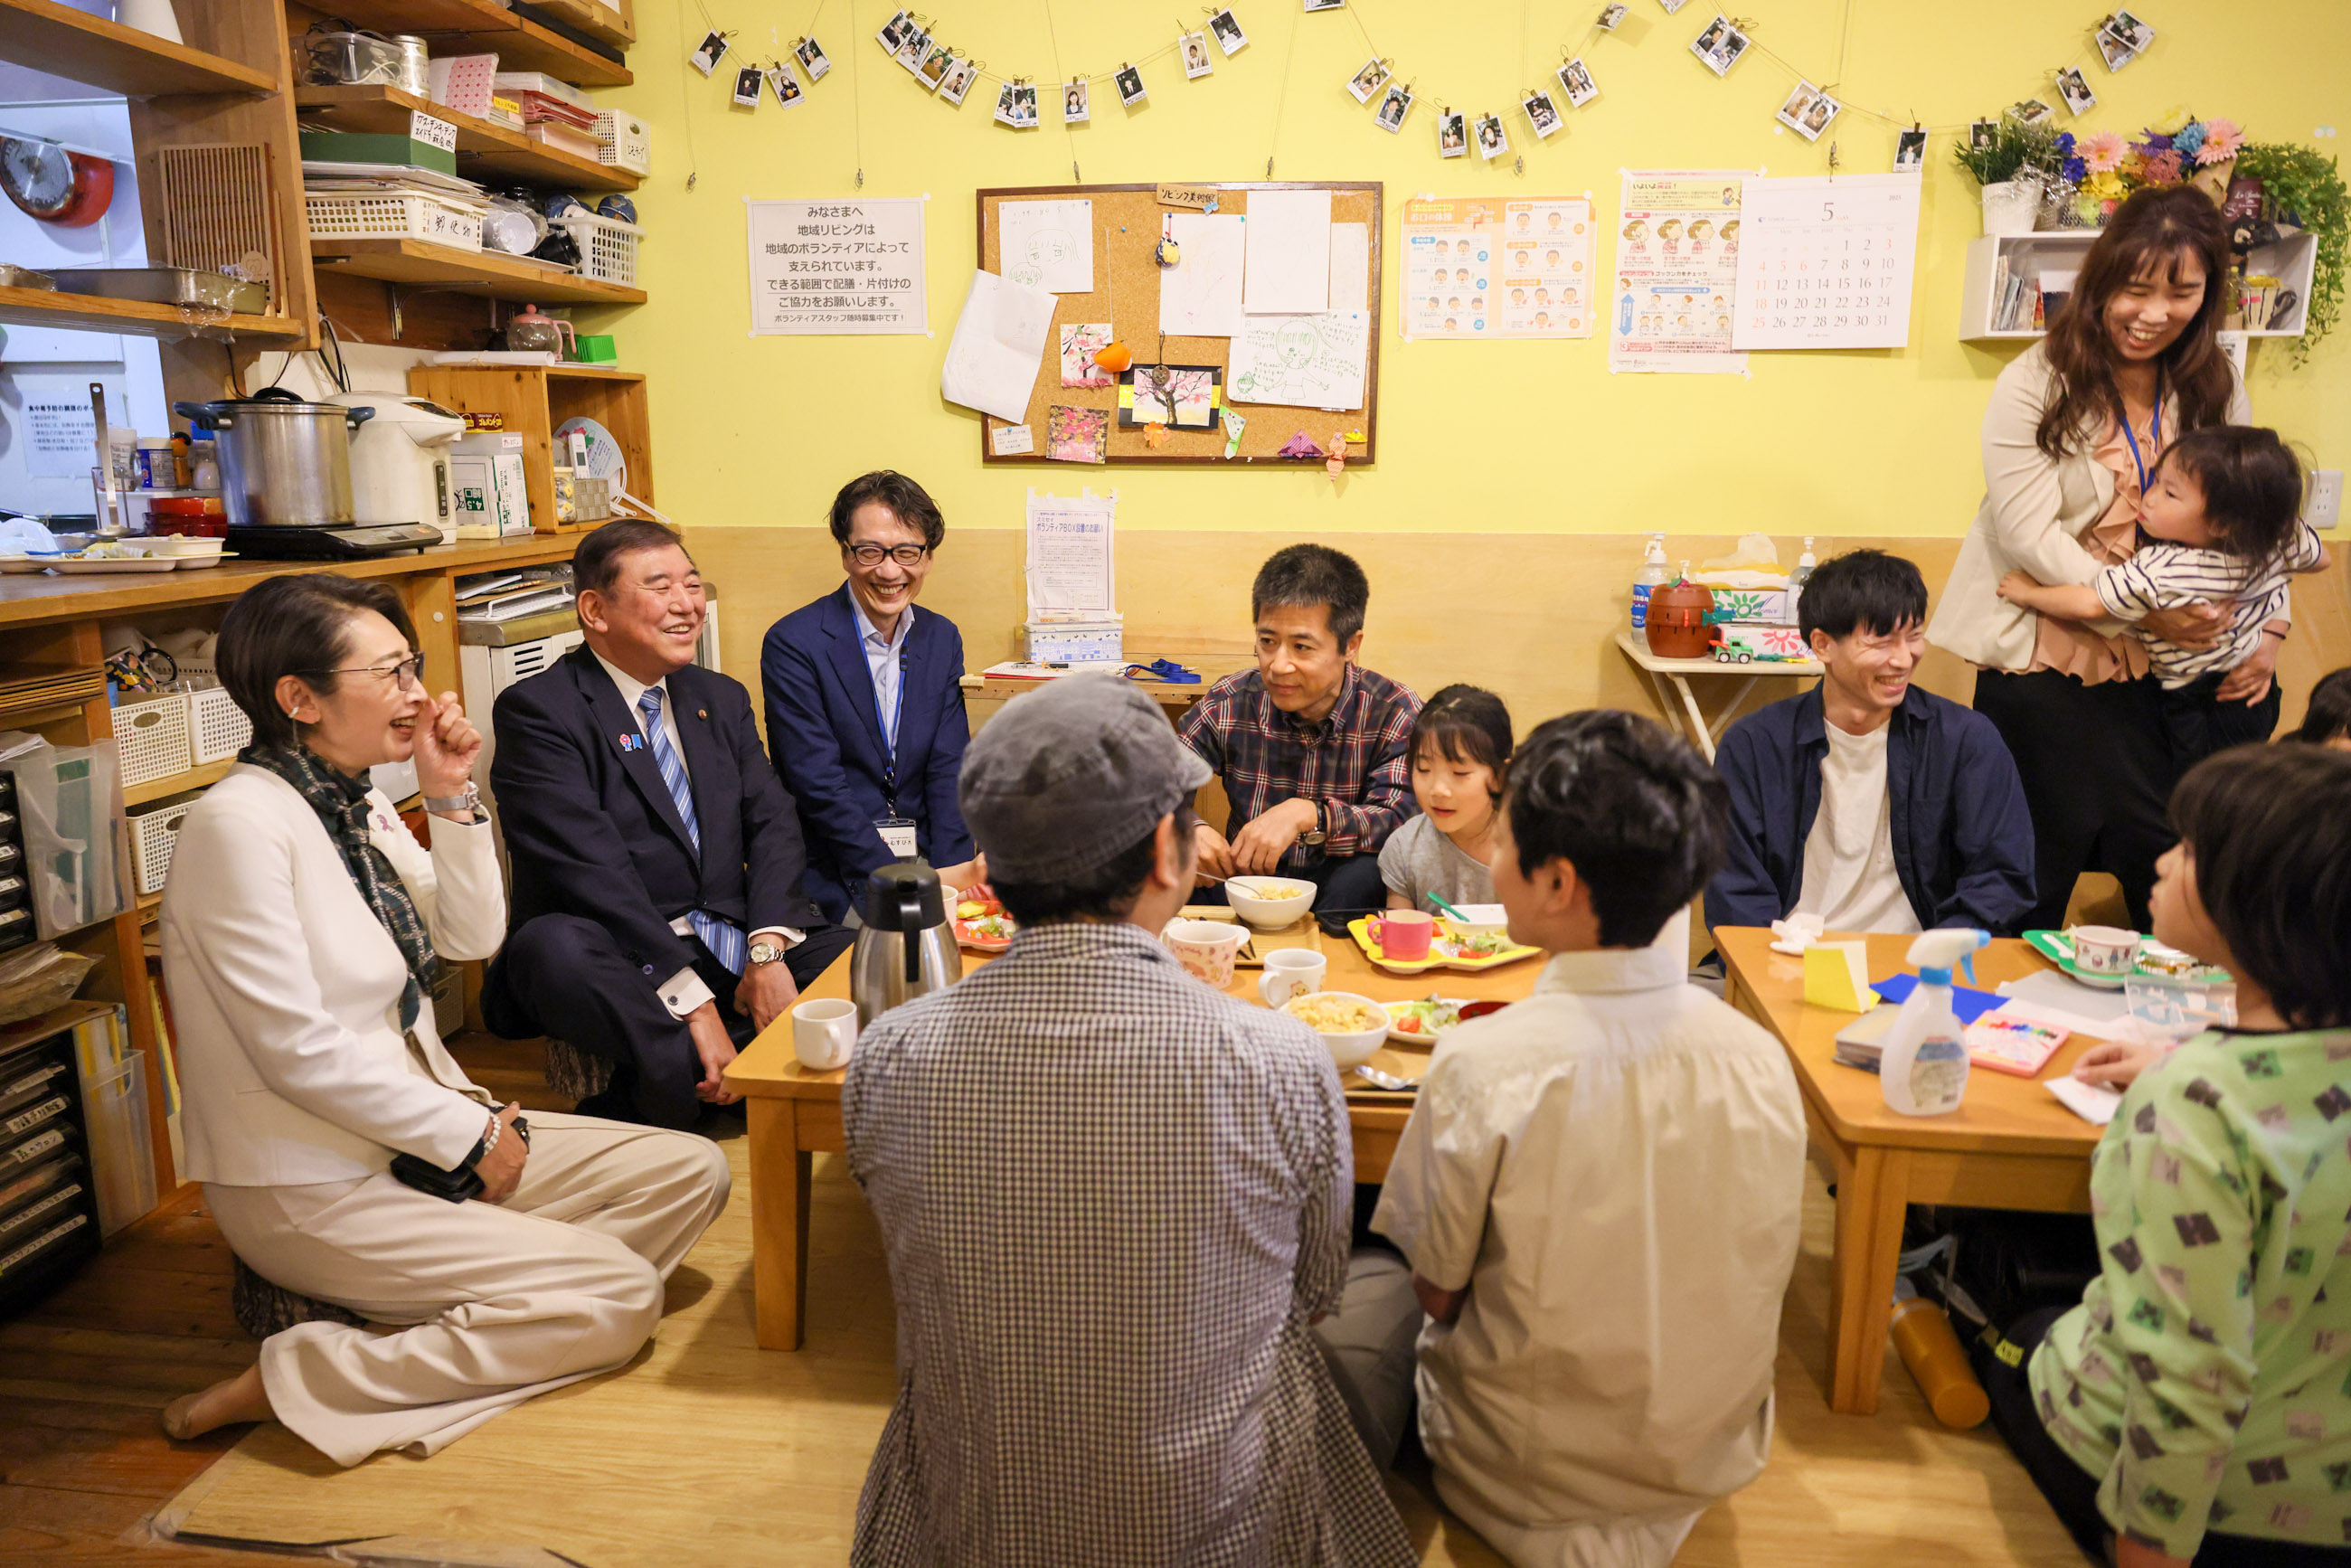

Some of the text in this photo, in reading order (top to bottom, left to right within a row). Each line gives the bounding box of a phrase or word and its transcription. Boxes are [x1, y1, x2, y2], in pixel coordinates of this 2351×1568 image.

[1161, 188, 1216, 203] リビング美術館
[807, 206, 864, 218] みなさまへ
[1821, 202, 1835, 222] 5
[435, 214, 471, 238] 郵便物
[798, 224, 875, 237] 地域リビングは
[765, 242, 910, 255] 地域のボランティアによって
[1844, 240, 1849, 251] 1
[1863, 239, 1872, 251] 2
[1884, 239, 1893, 250] 3
[788, 260, 883, 272] 支えられています。
[1759, 258, 1894, 272] 4 5 6 7 8 9 10
[767, 279, 911, 290] できる範囲で配膳・片付けの
[1756, 277, 1893, 290] 11 12 13 14 15 16 17
[779, 296, 895, 308] ご協力をお願いします。
[1754, 296, 1890, 309] 18 19 20 21 22 23 24
[775, 314, 904, 323] ボランティアスタッフ随時募集中です！
[1752, 315, 1888, 327] 25 26 27 28 29 30 31
[467, 500, 483, 510] 4.5
[1036, 524, 1104, 533] ボランティアBOX設置のお願い
